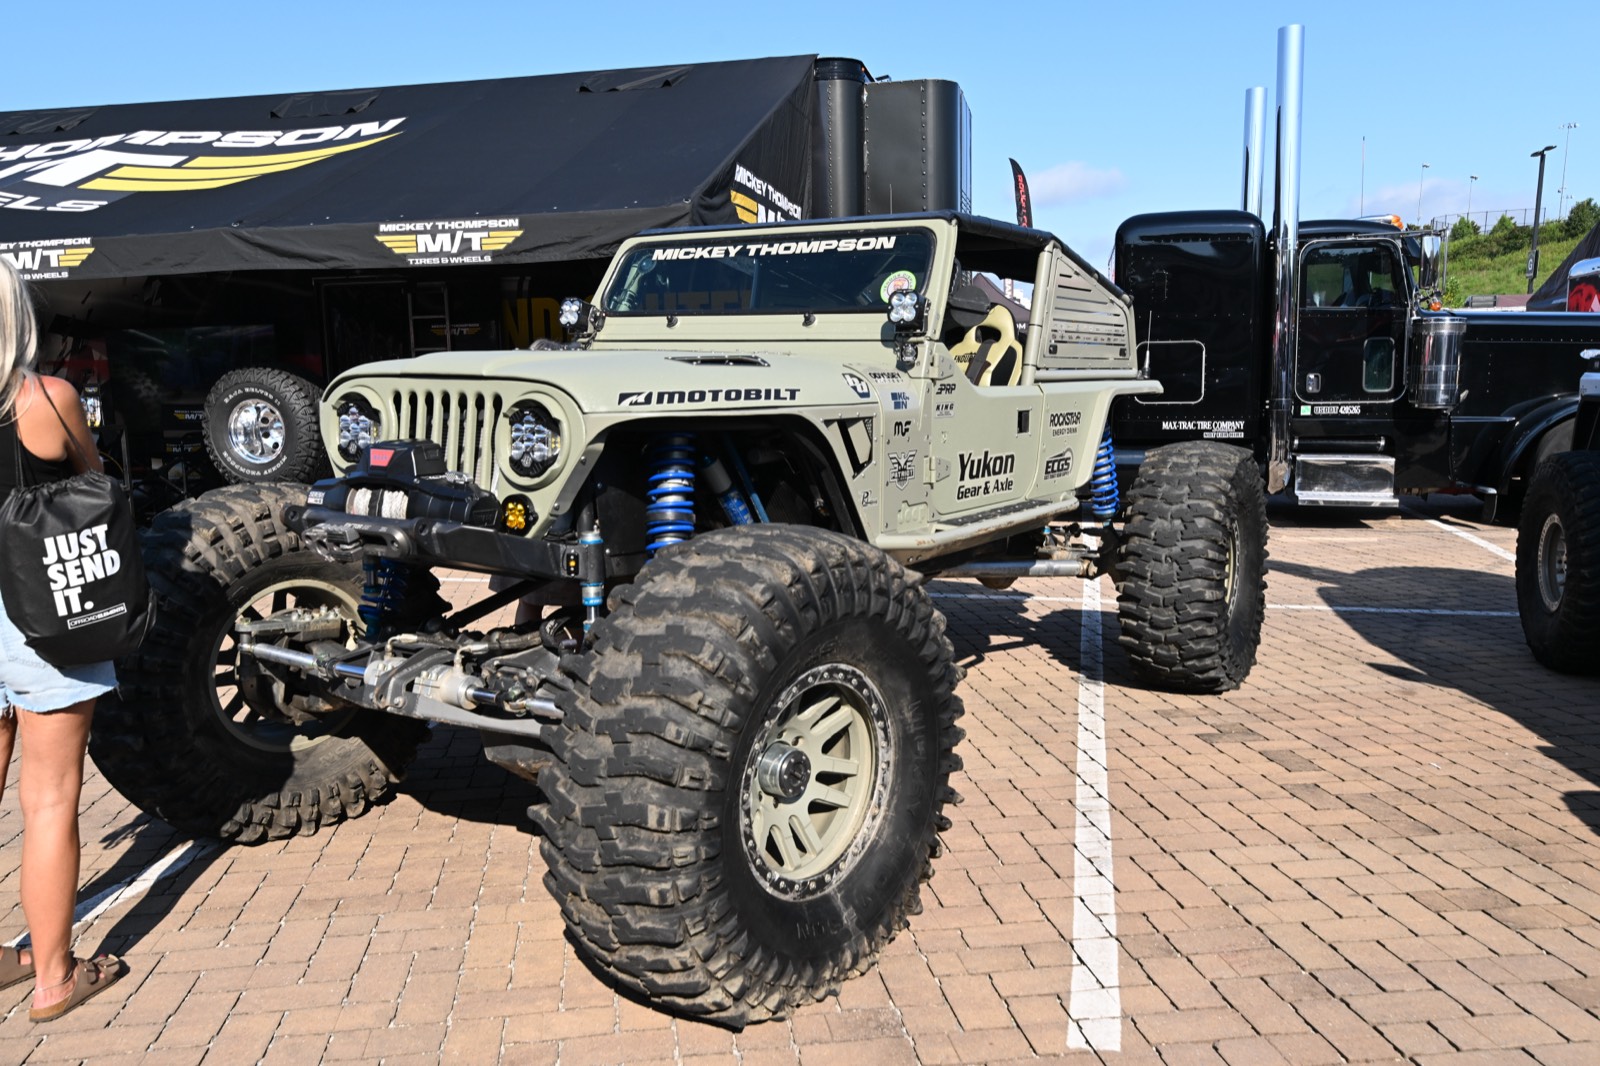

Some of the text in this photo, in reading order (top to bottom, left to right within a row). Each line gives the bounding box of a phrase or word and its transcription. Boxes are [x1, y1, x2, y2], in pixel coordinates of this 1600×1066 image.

[734, 163, 803, 221] MICKEY THOMPSON
[378, 217, 520, 233] MICKEY THOMPSON
[18, 236, 92, 249] THOMPSON
[416, 230, 490, 254] M/T
[651, 235, 898, 262] MICKEY THOMPSON
[407, 254, 492, 266] TIRES & WHEELS
[32, 270, 69, 279] WHEELS
[655, 388, 801, 405] MOTOBILT
[1049, 411, 1082, 428] ROCKSTAR
[1161, 420, 1245, 431] MAX-TRAC TIRE COMPANY
[958, 450, 1016, 482] Yukon
[1044, 456, 1071, 476] ECGS
[956, 477, 1014, 501] Gear & Axle
[42, 523, 109, 566] JUST
[47, 548, 121, 592] SEND
[52, 586, 95, 618] IT.
